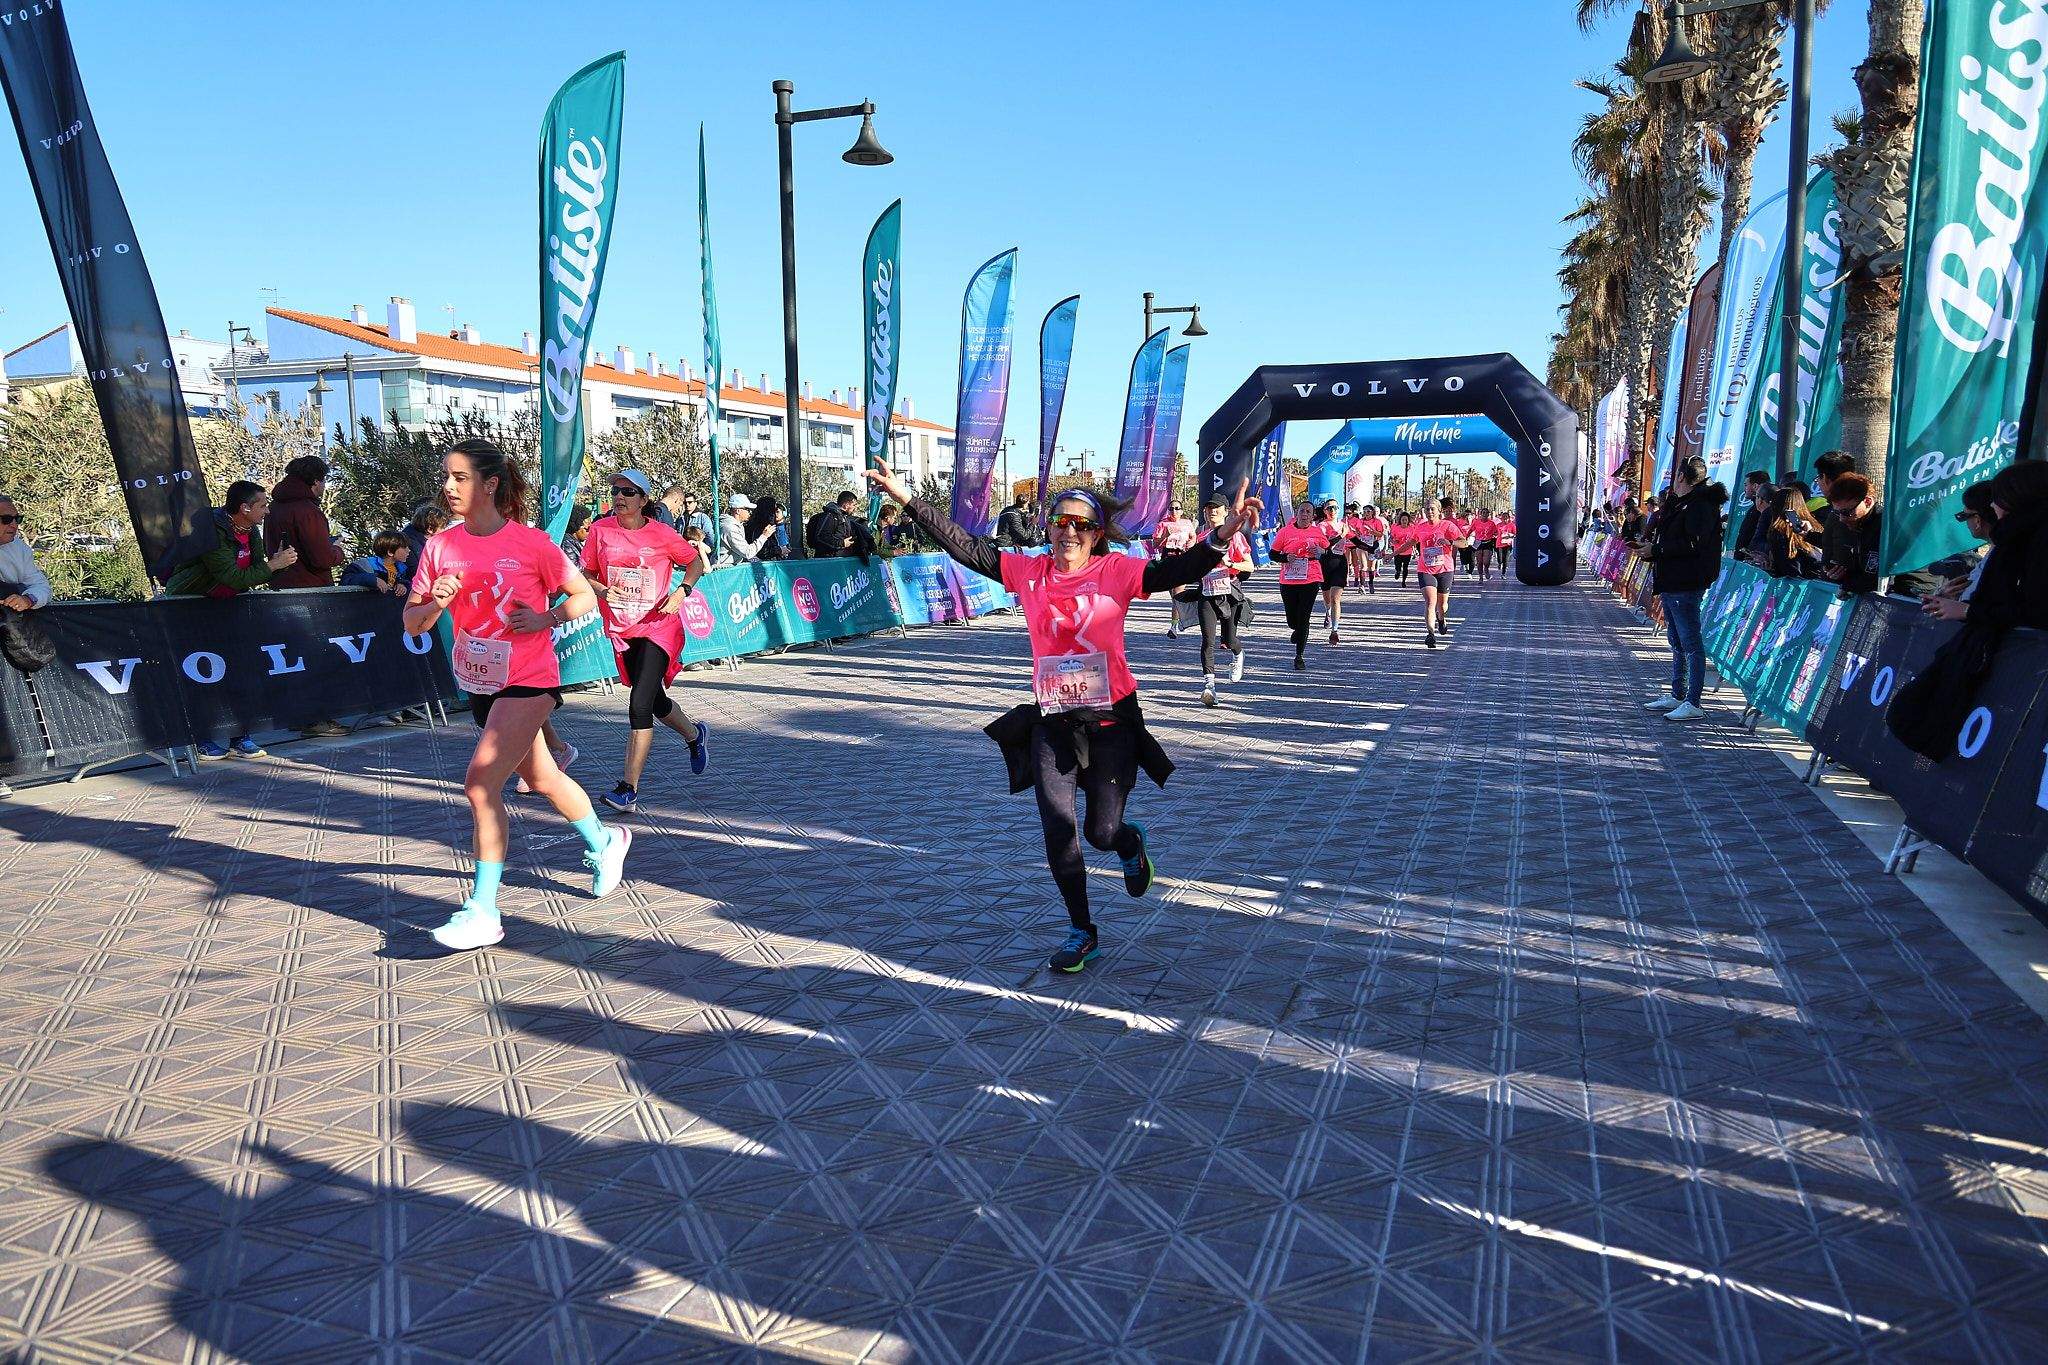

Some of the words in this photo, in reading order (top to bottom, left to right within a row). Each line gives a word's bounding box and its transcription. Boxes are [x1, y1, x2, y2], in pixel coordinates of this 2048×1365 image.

[544, 136, 607, 424] Batiste
[1738, 275, 1763, 369] Odontológicos
[1293, 376, 1464, 398] VOLVO
[1694, 347, 1707, 402] Institutos
[1394, 421, 1461, 451] Marlene
[1266, 441, 1276, 487] GOYA
[1537, 442, 1551, 568] VOLVO
[1909, 479, 1966, 508] CHAMPÚ
[1974, 468, 1990, 483] EN
[728, 575, 777, 624] Batiste
[830, 569, 870, 610] Batiste
[838, 606, 856, 624] CHAMPÚ
[856, 599, 863, 609] EN
[863, 590, 875, 604] SECO
[76, 631, 434, 695] VOLVO
[465, 661, 488, 675] 016
